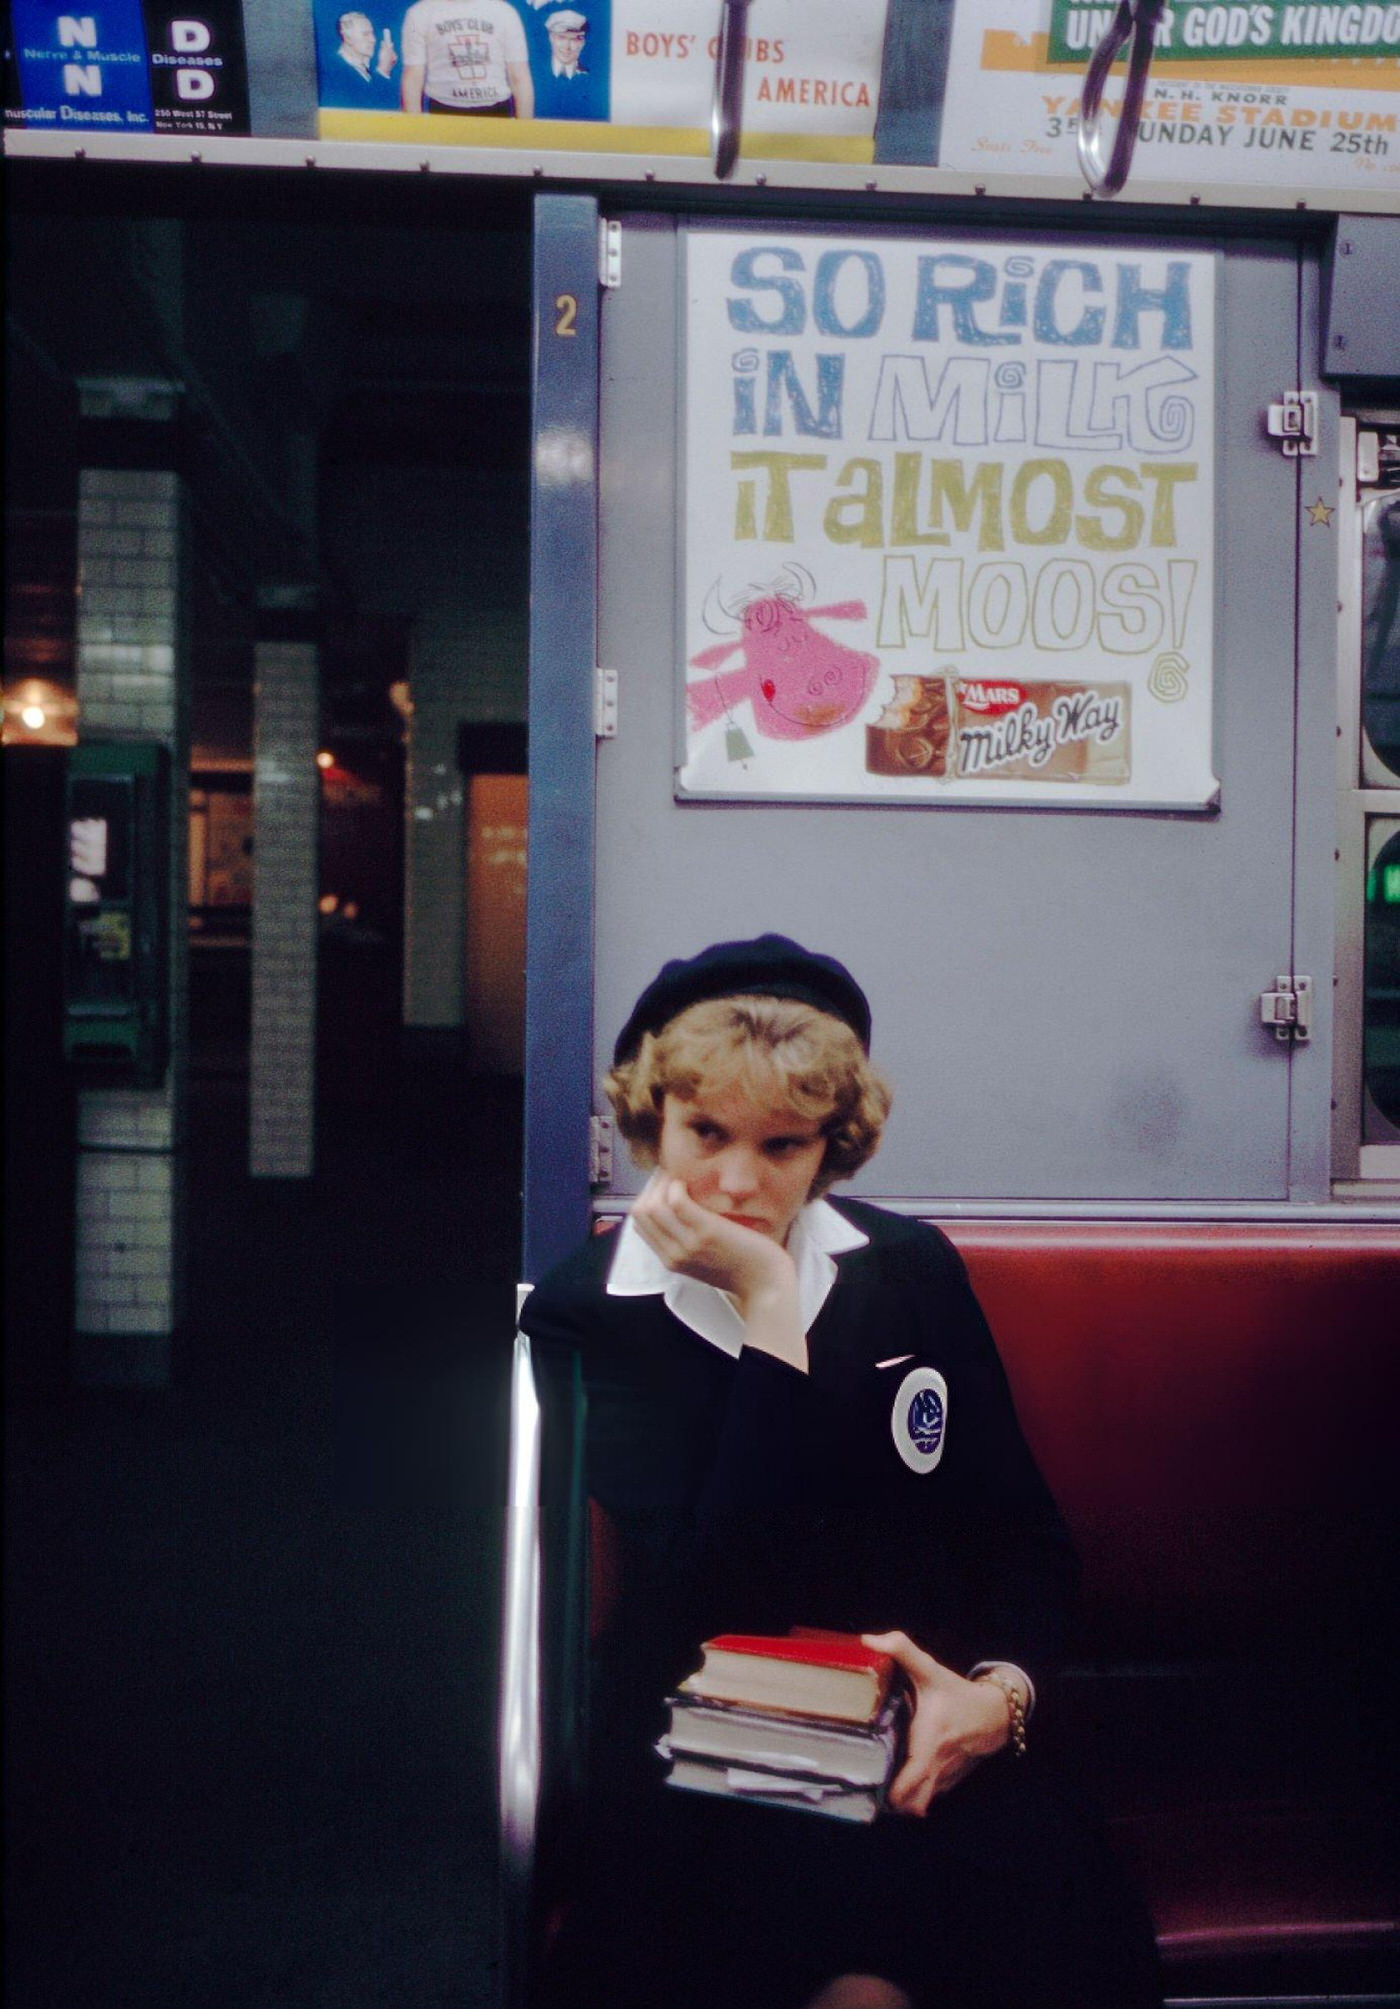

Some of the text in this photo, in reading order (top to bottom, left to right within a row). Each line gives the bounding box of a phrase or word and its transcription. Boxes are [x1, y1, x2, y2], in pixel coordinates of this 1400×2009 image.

[57, 16, 211, 52] N D
[1066, 7, 1175, 50] UNR
[1183, 3, 1275, 47] GOD'S
[24, 48, 223, 66] Nerve & Muscle Diseases
[626, 29, 786, 63] BOYS' CBS
[64, 64, 215, 100] N D
[757, 76, 871, 108] AMERICA
[1211, 91, 1288, 106] KNORR
[1216, 104, 1397, 132] STADIUM
[1136, 120, 1234, 147] UNDAY
[1244, 126, 1316, 152] JUNE
[1330, 131, 1390, 156] 25th
[725, 246, 885, 340] SO
[556, 294, 577, 336] 2
[876, 554, 1199, 704] MOOS!
[963, 684, 1021, 710] MARS
[960, 691, 1124, 772] Milky Way
